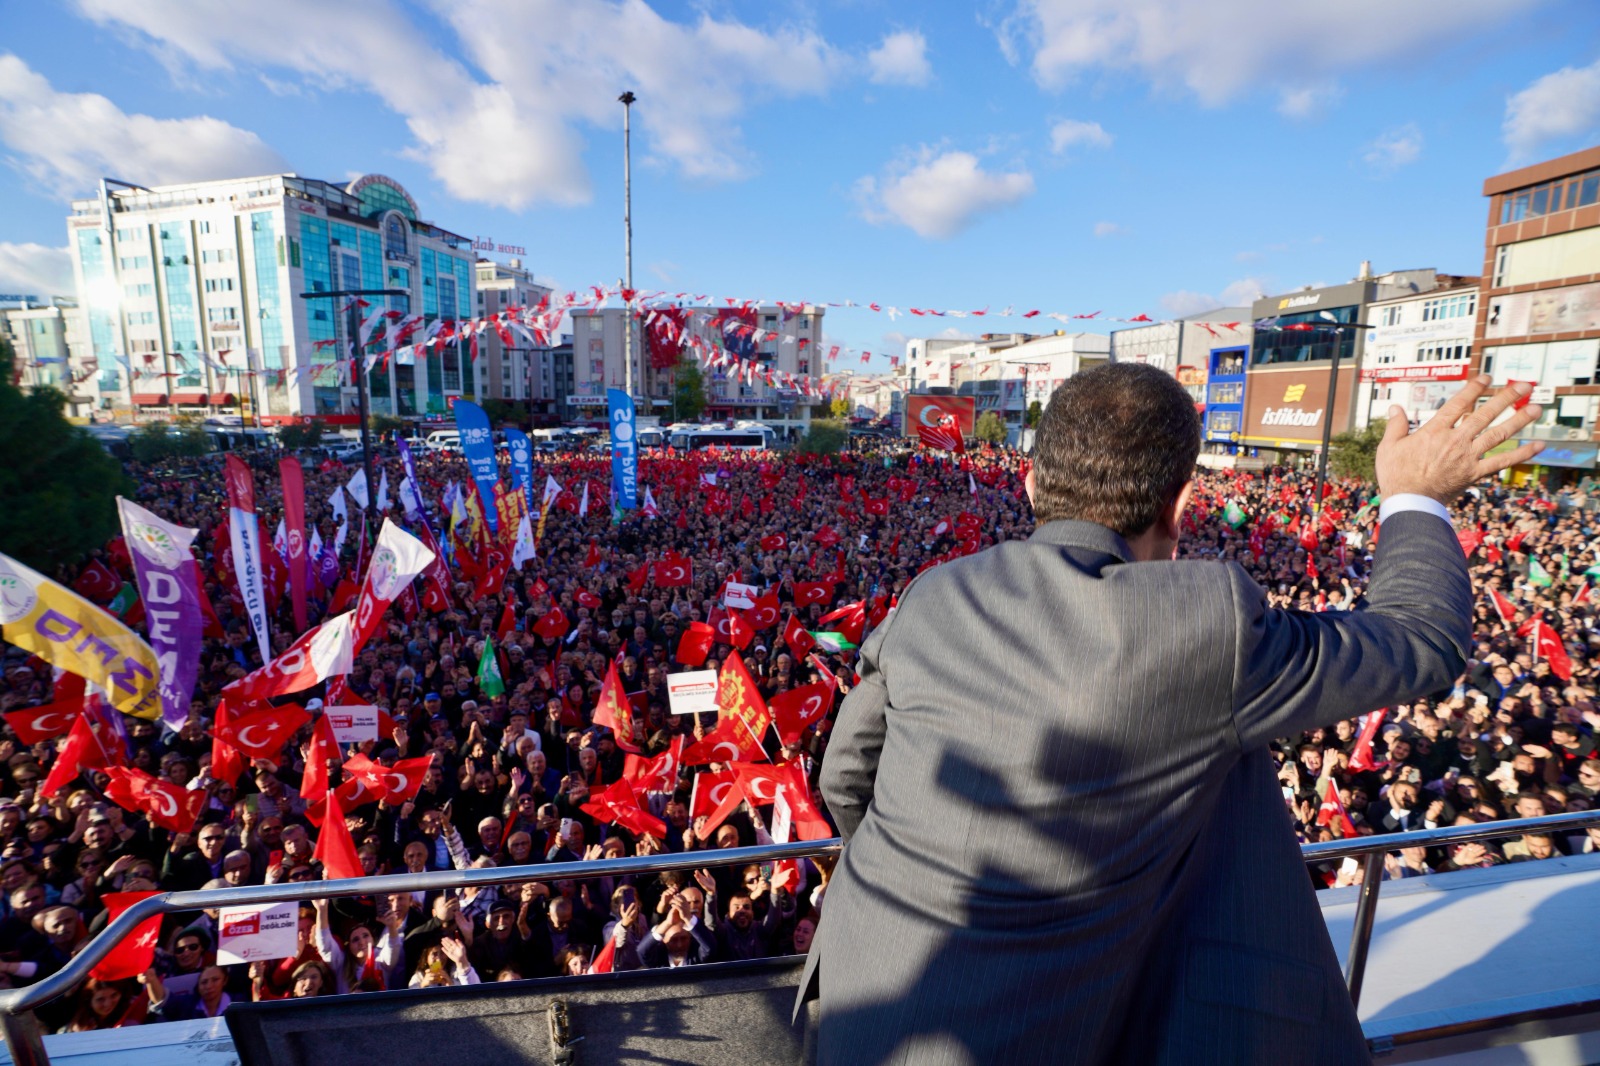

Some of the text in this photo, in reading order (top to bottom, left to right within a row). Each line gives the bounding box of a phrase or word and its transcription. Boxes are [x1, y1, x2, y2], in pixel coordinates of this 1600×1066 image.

[498, 243, 527, 256] HOTEL
[1288, 293, 1321, 309] istikbal
[1261, 406, 1323, 427] istikbal
[228, 923, 254, 935] ÖZER
